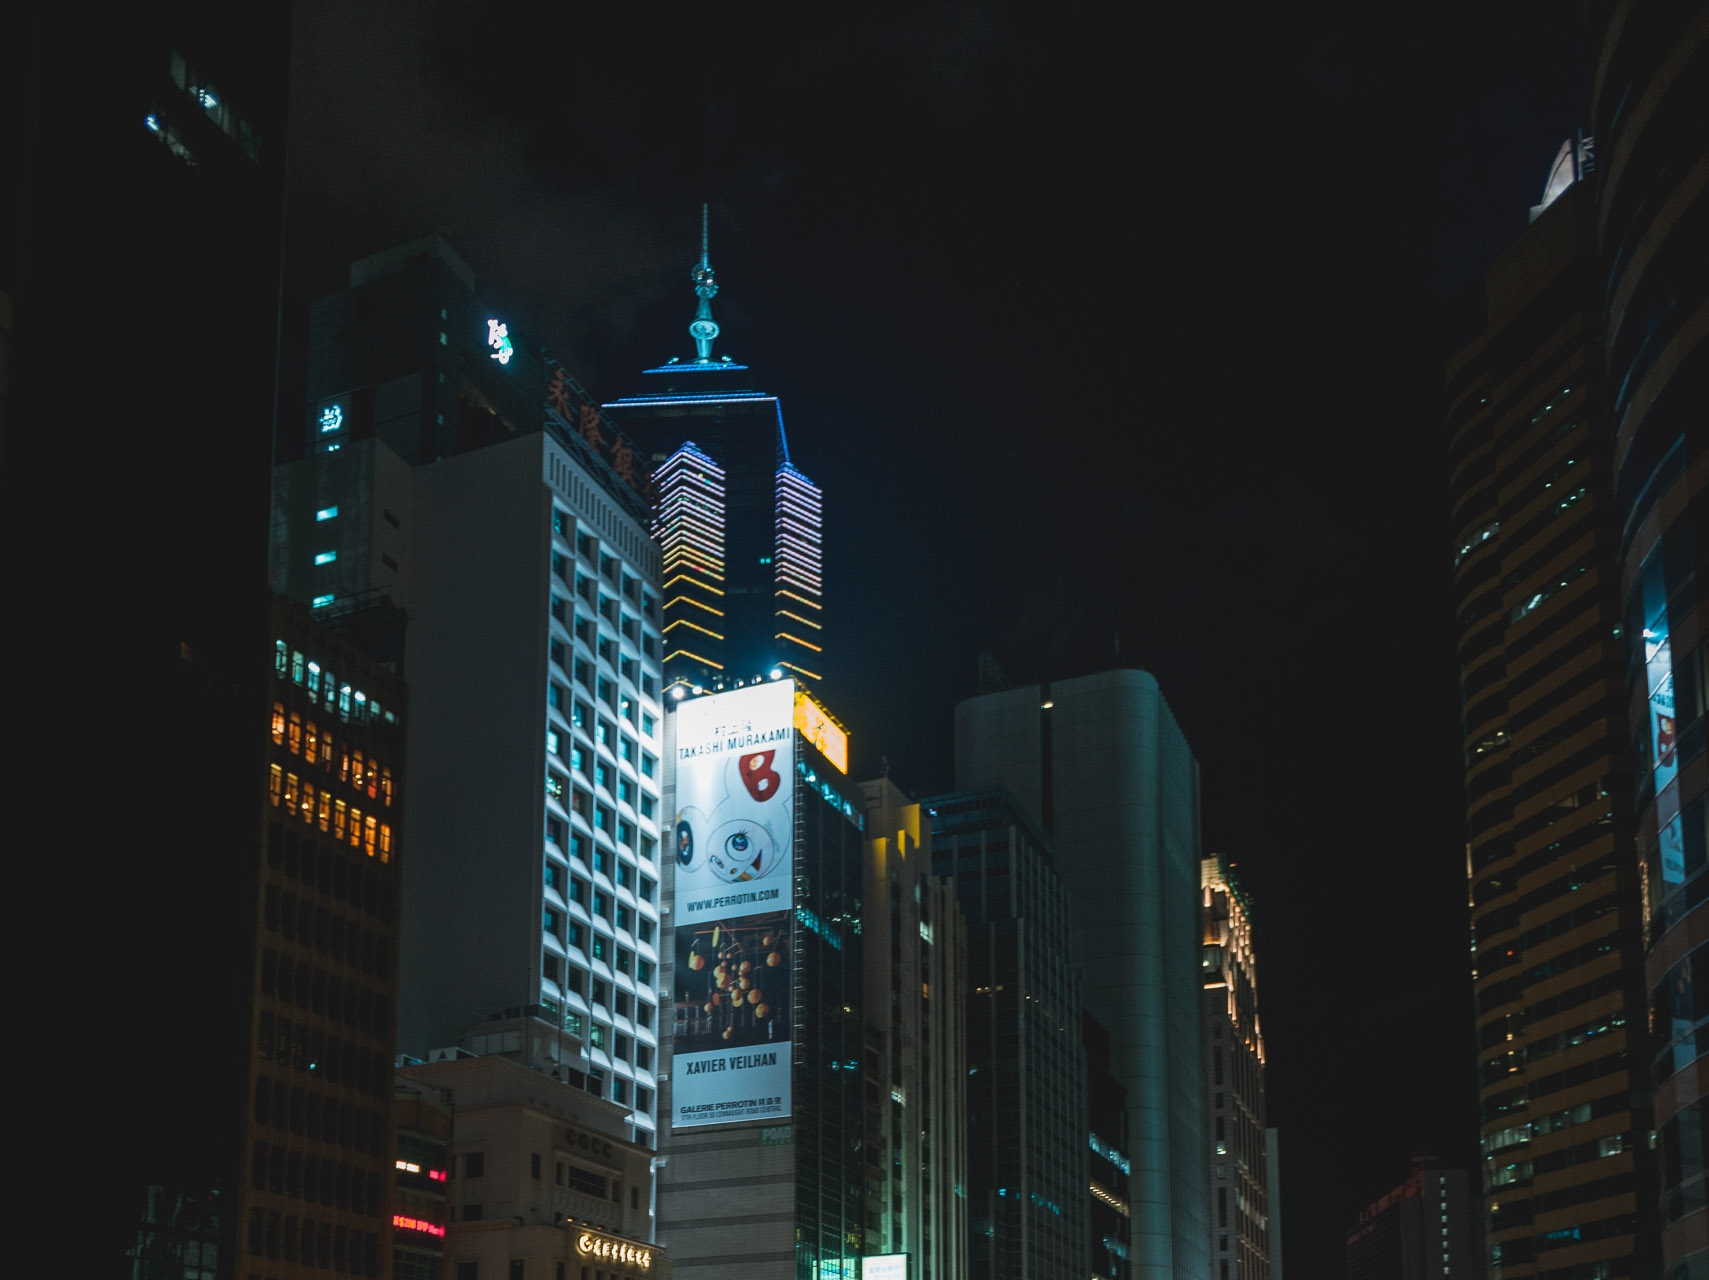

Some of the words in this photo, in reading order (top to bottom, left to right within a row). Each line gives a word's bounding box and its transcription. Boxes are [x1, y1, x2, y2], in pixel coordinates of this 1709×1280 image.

[679, 740, 723, 760] TAKASHI
[727, 727, 790, 750] MURAKAMI
[686, 888, 779, 912] WWW.PERROTIN.COM
[686, 1058, 726, 1075] XAVIER
[729, 1052, 777, 1070] VEILHAN
[680, 1103, 714, 1114] GALERIE
[715, 1098, 757, 1110] PERROTIN
